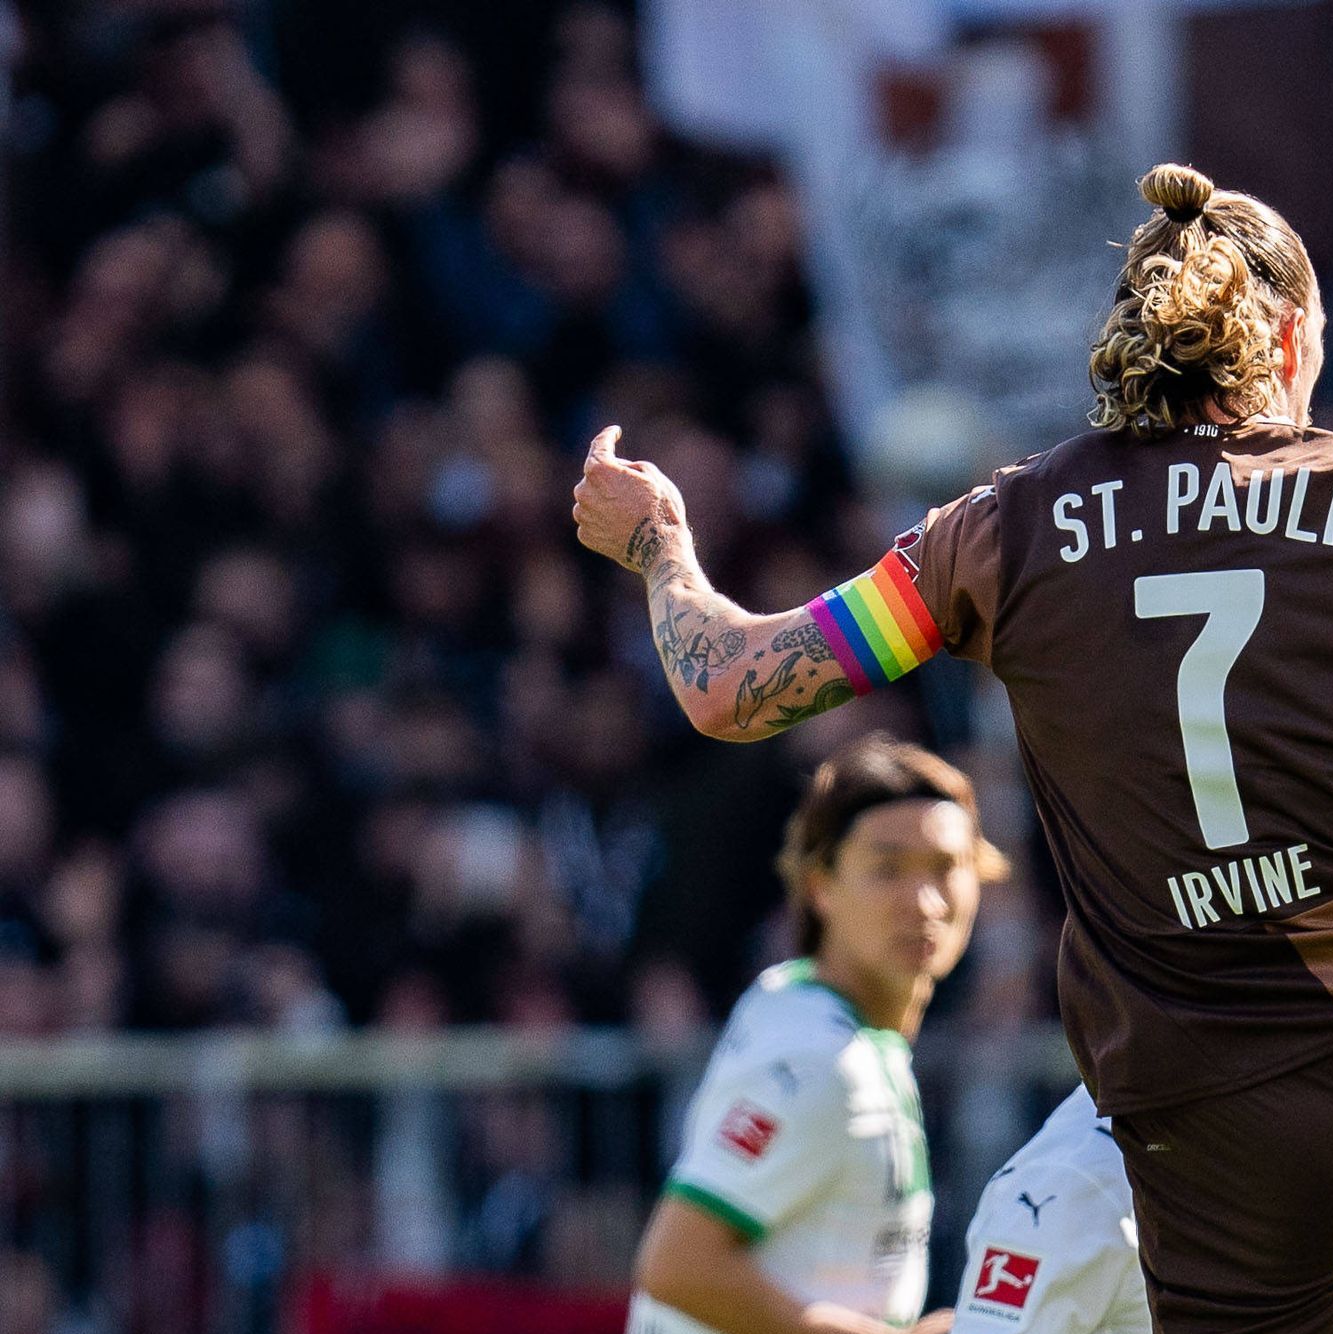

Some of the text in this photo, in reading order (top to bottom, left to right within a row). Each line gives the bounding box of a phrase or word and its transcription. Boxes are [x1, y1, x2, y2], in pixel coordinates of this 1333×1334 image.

[1053, 480, 1143, 563] ST.
[1134, 568, 1265, 850] 7
[1167, 843, 1321, 930] IRVINE
